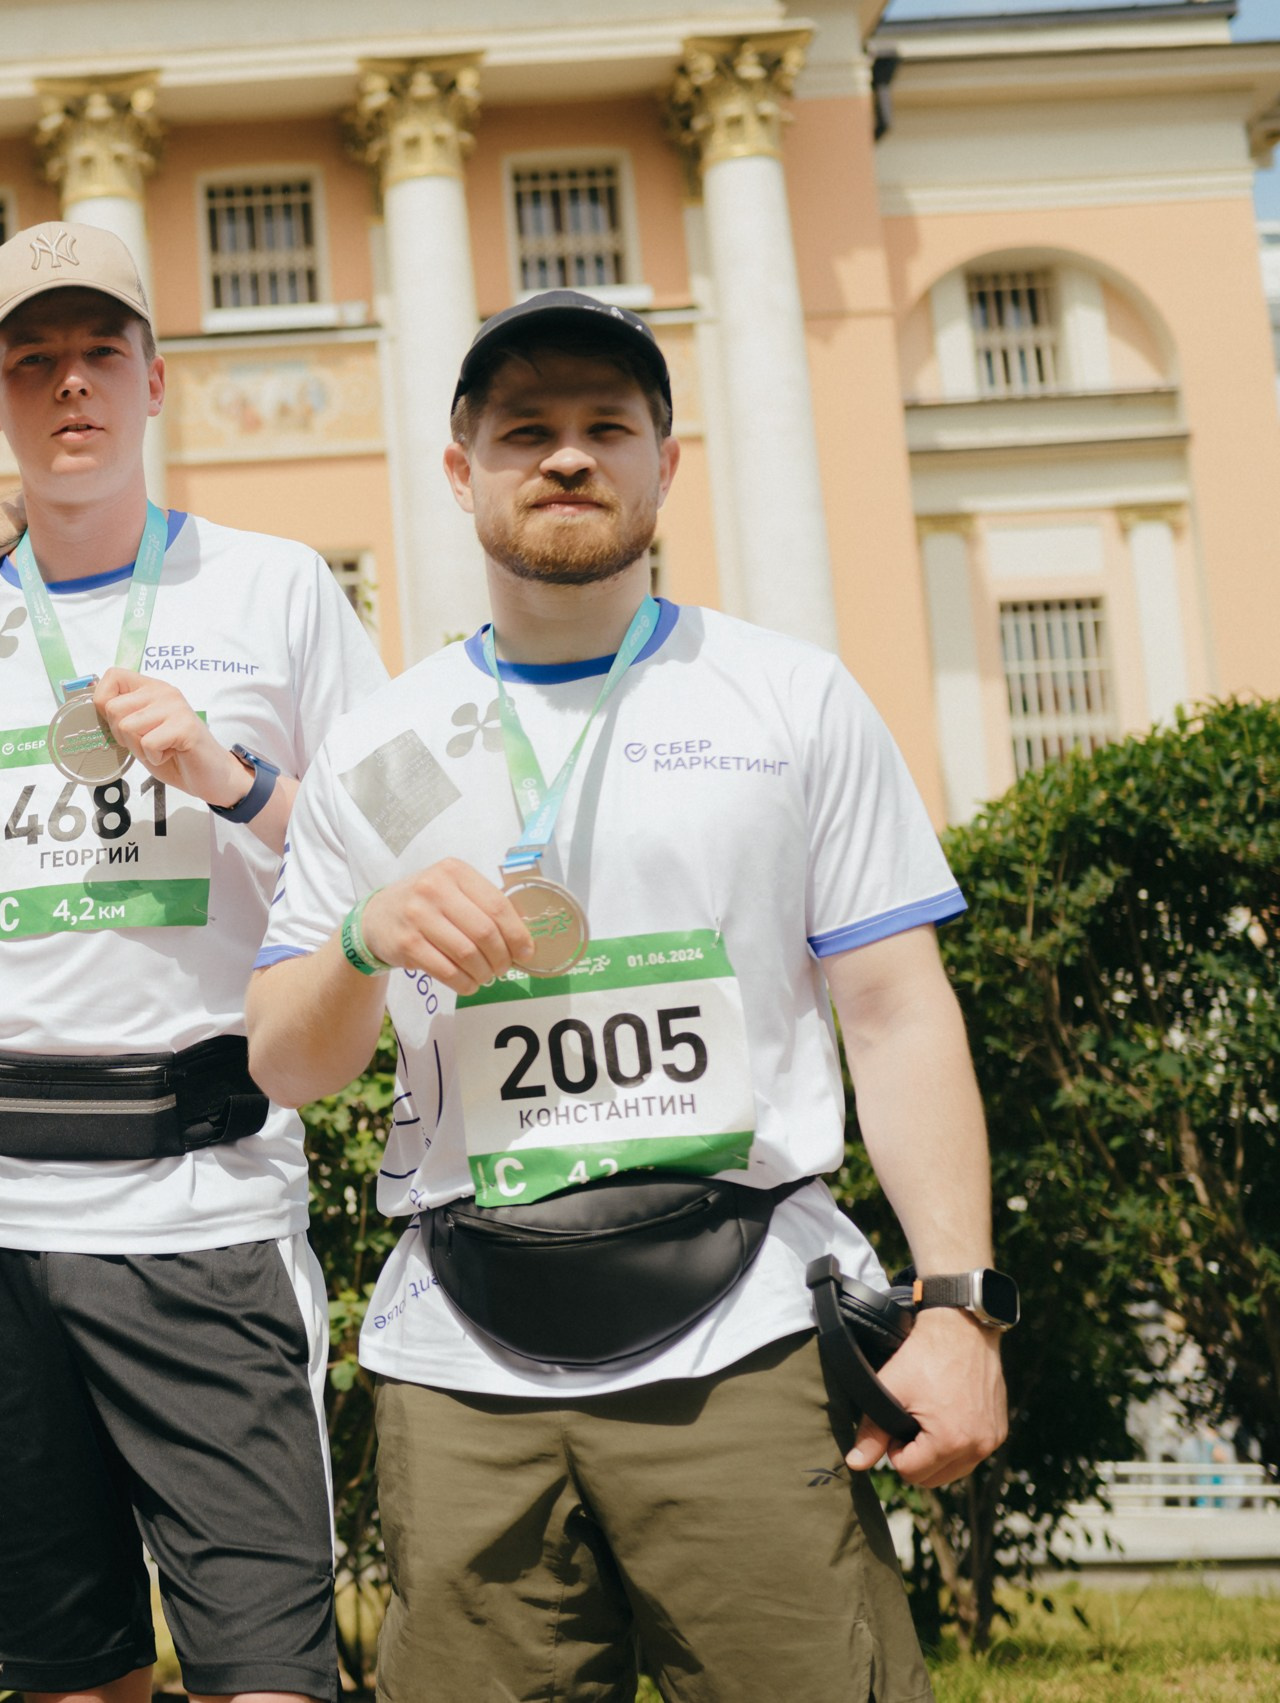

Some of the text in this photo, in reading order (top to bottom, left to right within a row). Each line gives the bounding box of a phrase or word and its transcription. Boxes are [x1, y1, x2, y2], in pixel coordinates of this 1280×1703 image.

[145, 645, 195, 657] СБЕР
[144, 659, 260, 675] МАРКЕТИНГ
[17, 739, 46, 752] СБЕР
[653, 739, 712, 756] СБЕР
[654, 756, 790, 776] МАРКЕТИНГ
[4, 775, 167, 845] 4681
[40, 842, 139, 869] ГЕОРГИЙ
[627, 947, 704, 968] 01.06.2024
[494, 1005, 708, 1101] 2005
[519, 1094, 697, 1130] КОНСТАНТИН
